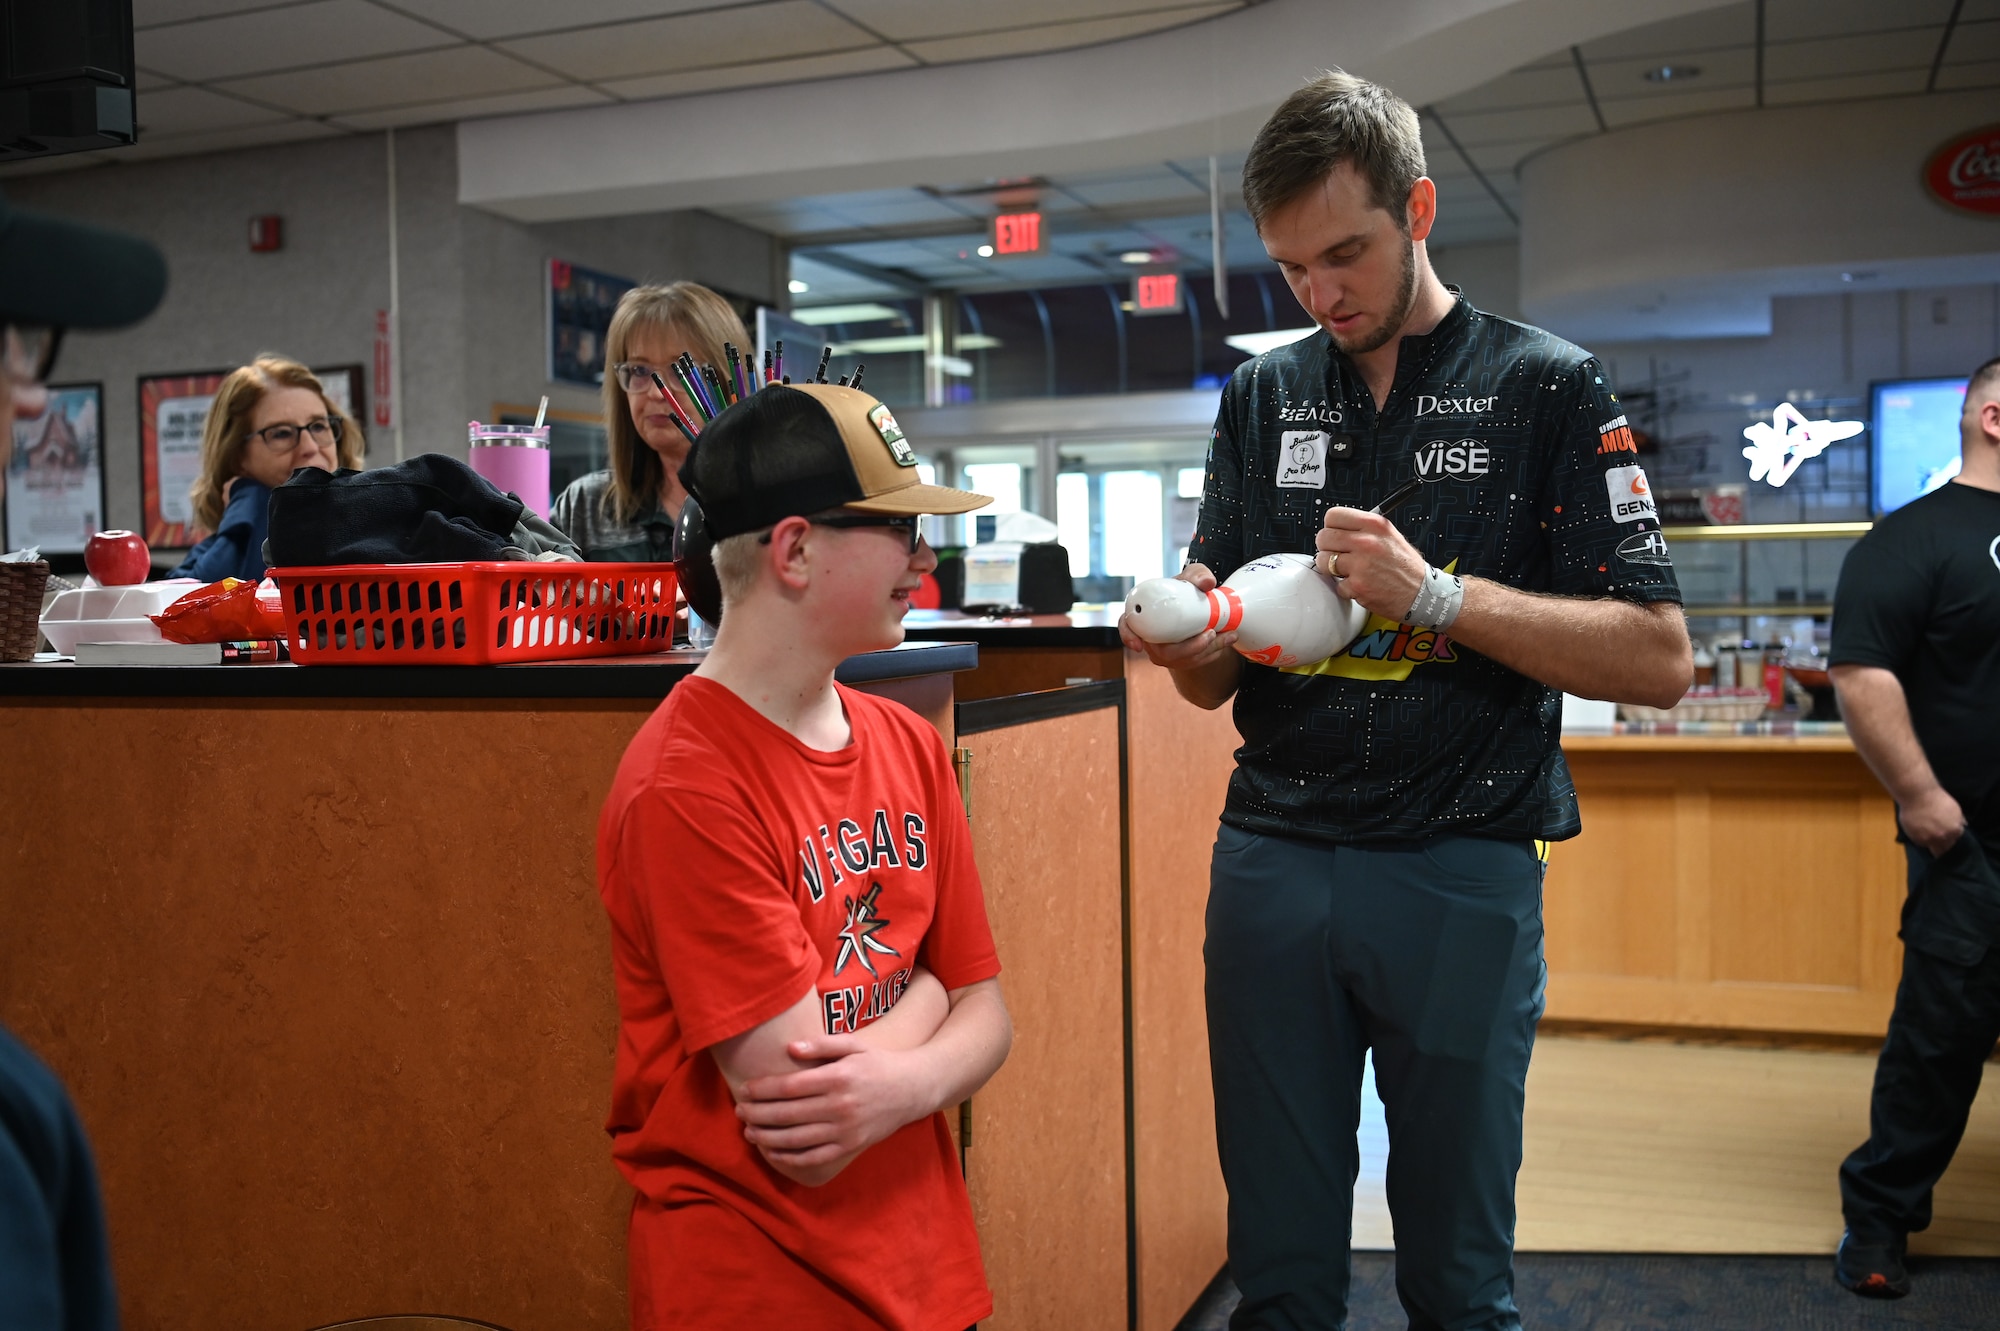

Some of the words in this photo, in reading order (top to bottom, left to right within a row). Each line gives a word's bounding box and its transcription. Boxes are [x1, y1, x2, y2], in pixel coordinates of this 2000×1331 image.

[1947, 143, 2000, 188] Coc
[995, 212, 1041, 254] EXIT
[1138, 274, 1178, 309] EXIT
[1414, 395, 1499, 417] Dexter
[799, 808, 928, 904] VEGAS
